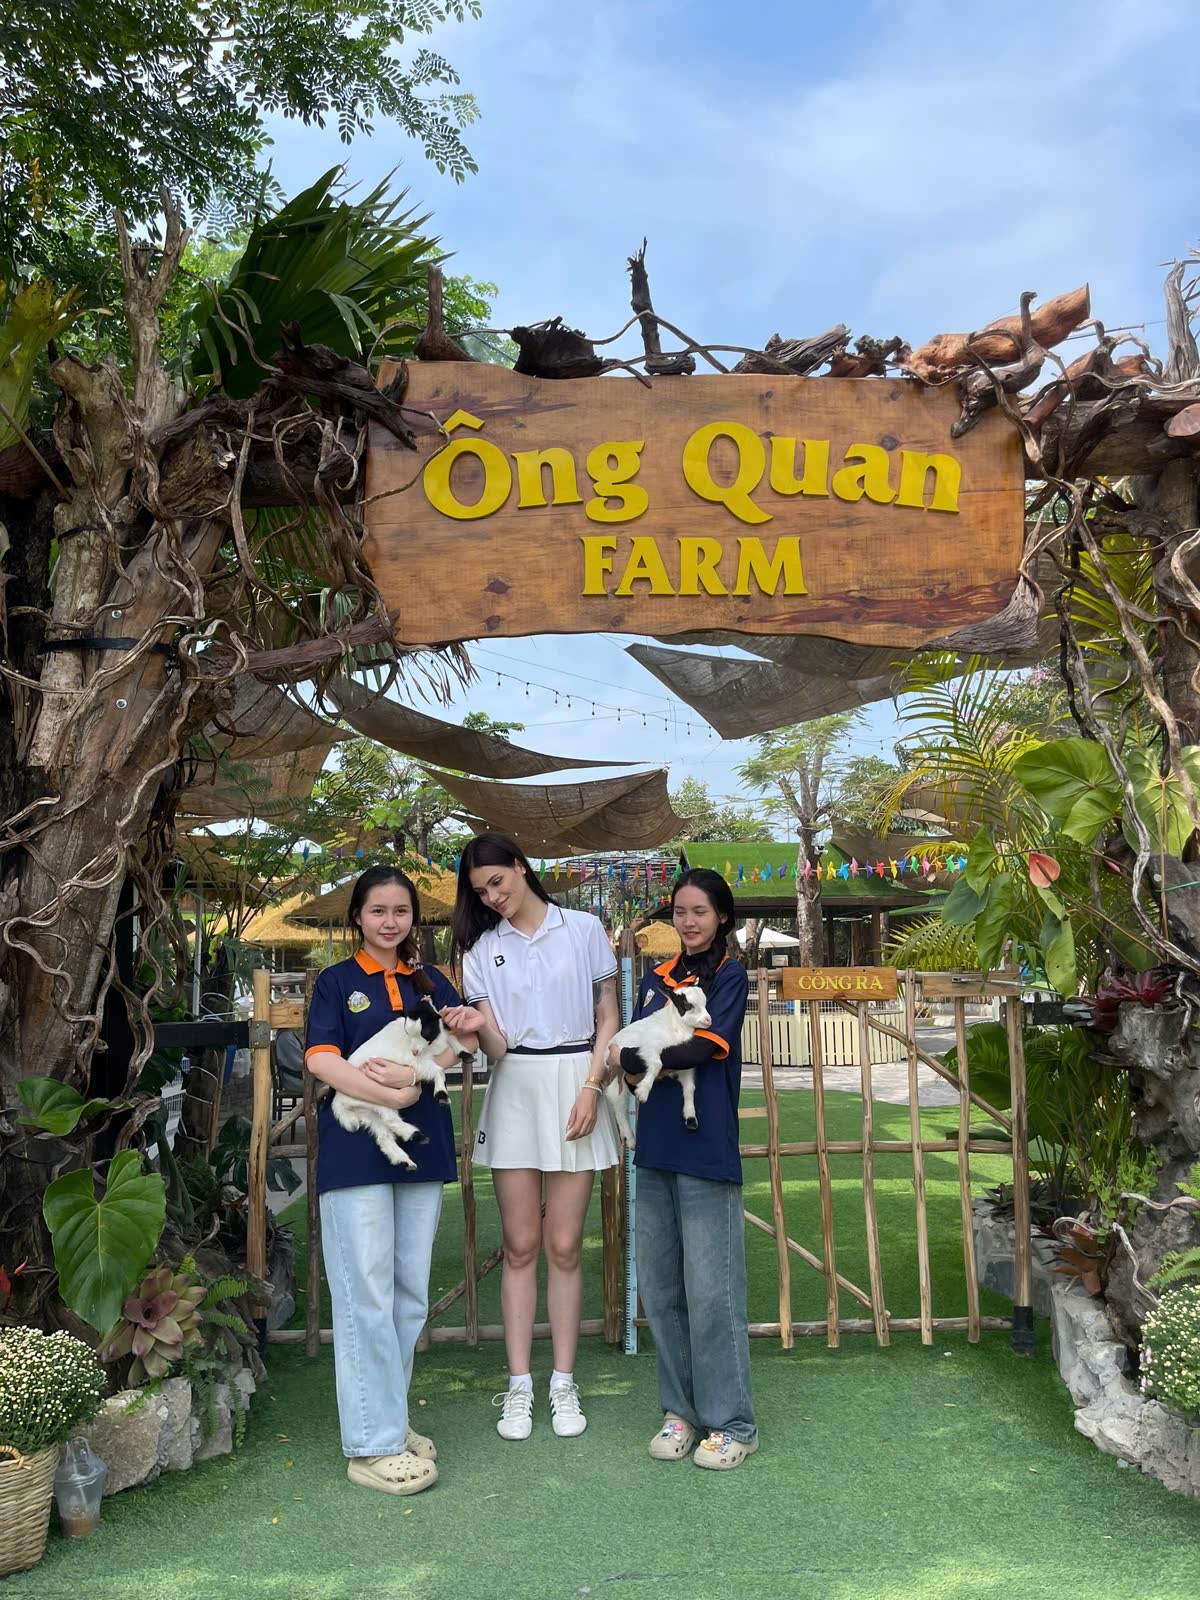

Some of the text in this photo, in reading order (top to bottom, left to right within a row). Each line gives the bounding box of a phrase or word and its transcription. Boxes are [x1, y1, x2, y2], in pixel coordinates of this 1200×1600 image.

[423, 409, 961, 524] Ông Quan
[581, 536, 809, 597] FARM
[855, 975, 884, 991] RA
